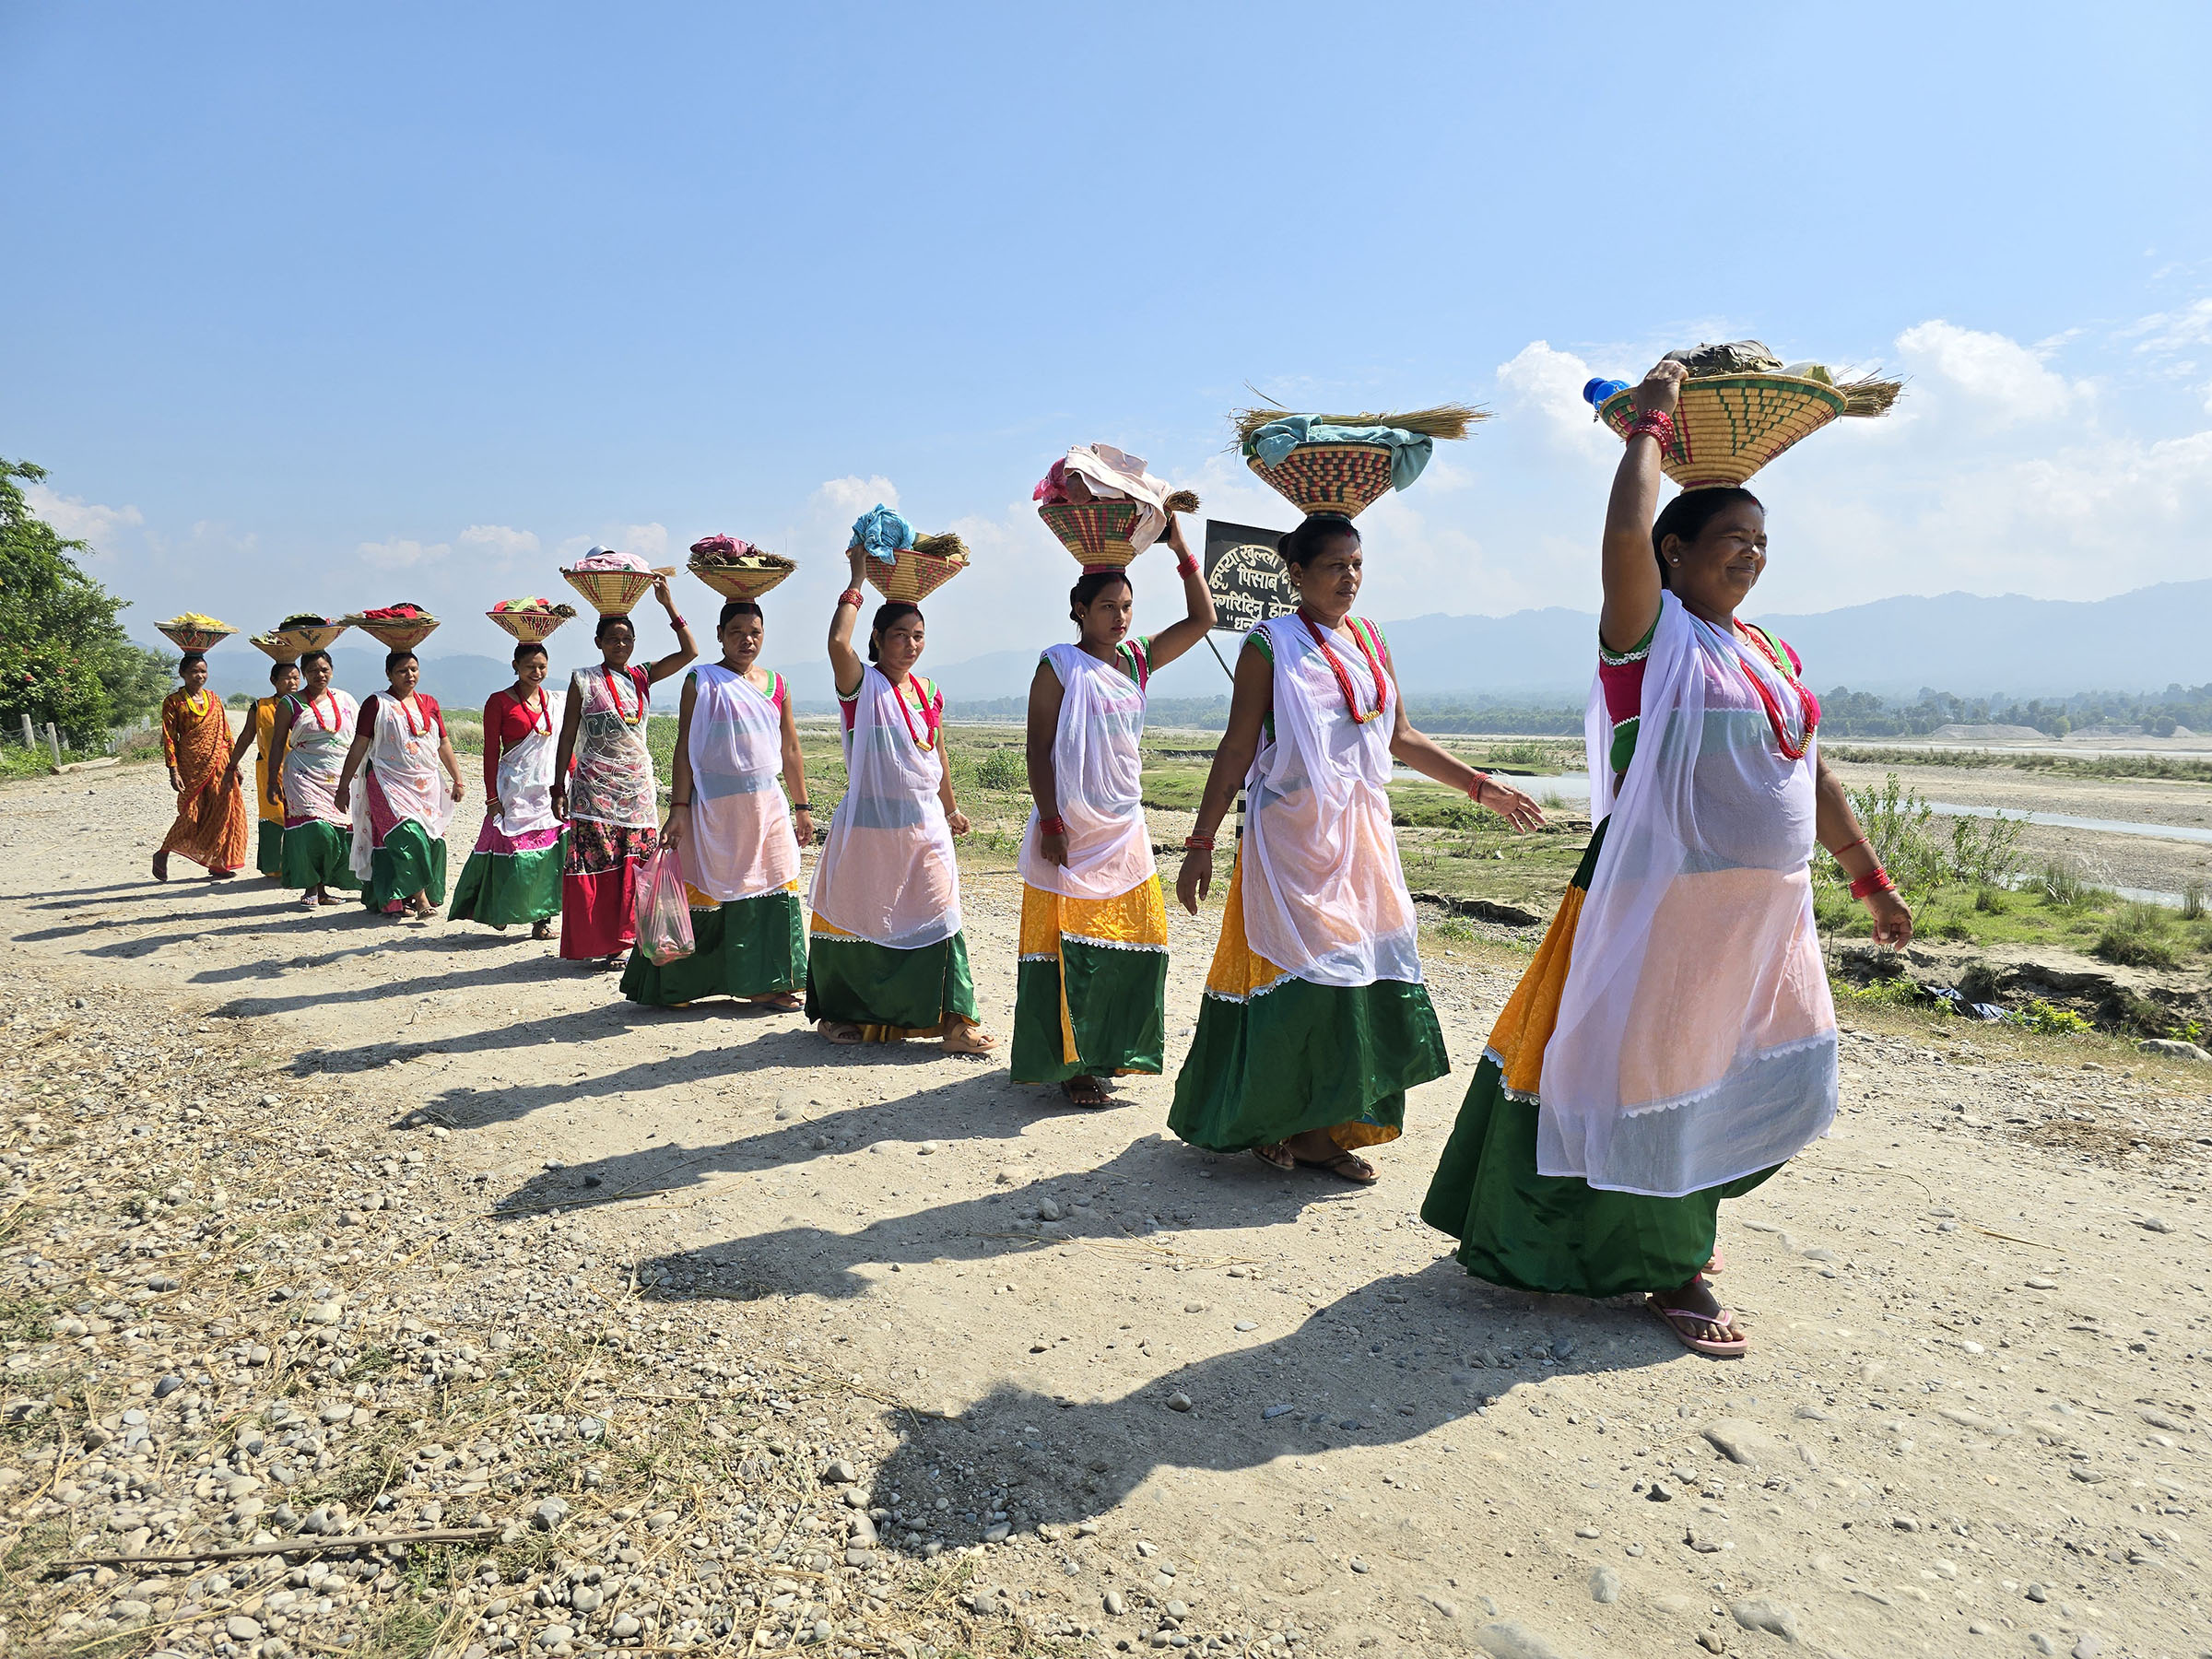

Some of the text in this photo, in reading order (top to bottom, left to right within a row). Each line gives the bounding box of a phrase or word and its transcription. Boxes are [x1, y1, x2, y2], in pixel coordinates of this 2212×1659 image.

[1208, 547, 1241, 590] कृपया
[1240, 545, 1279, 569] खुल्ला
[1237, 563, 1279, 592] पिसाब
